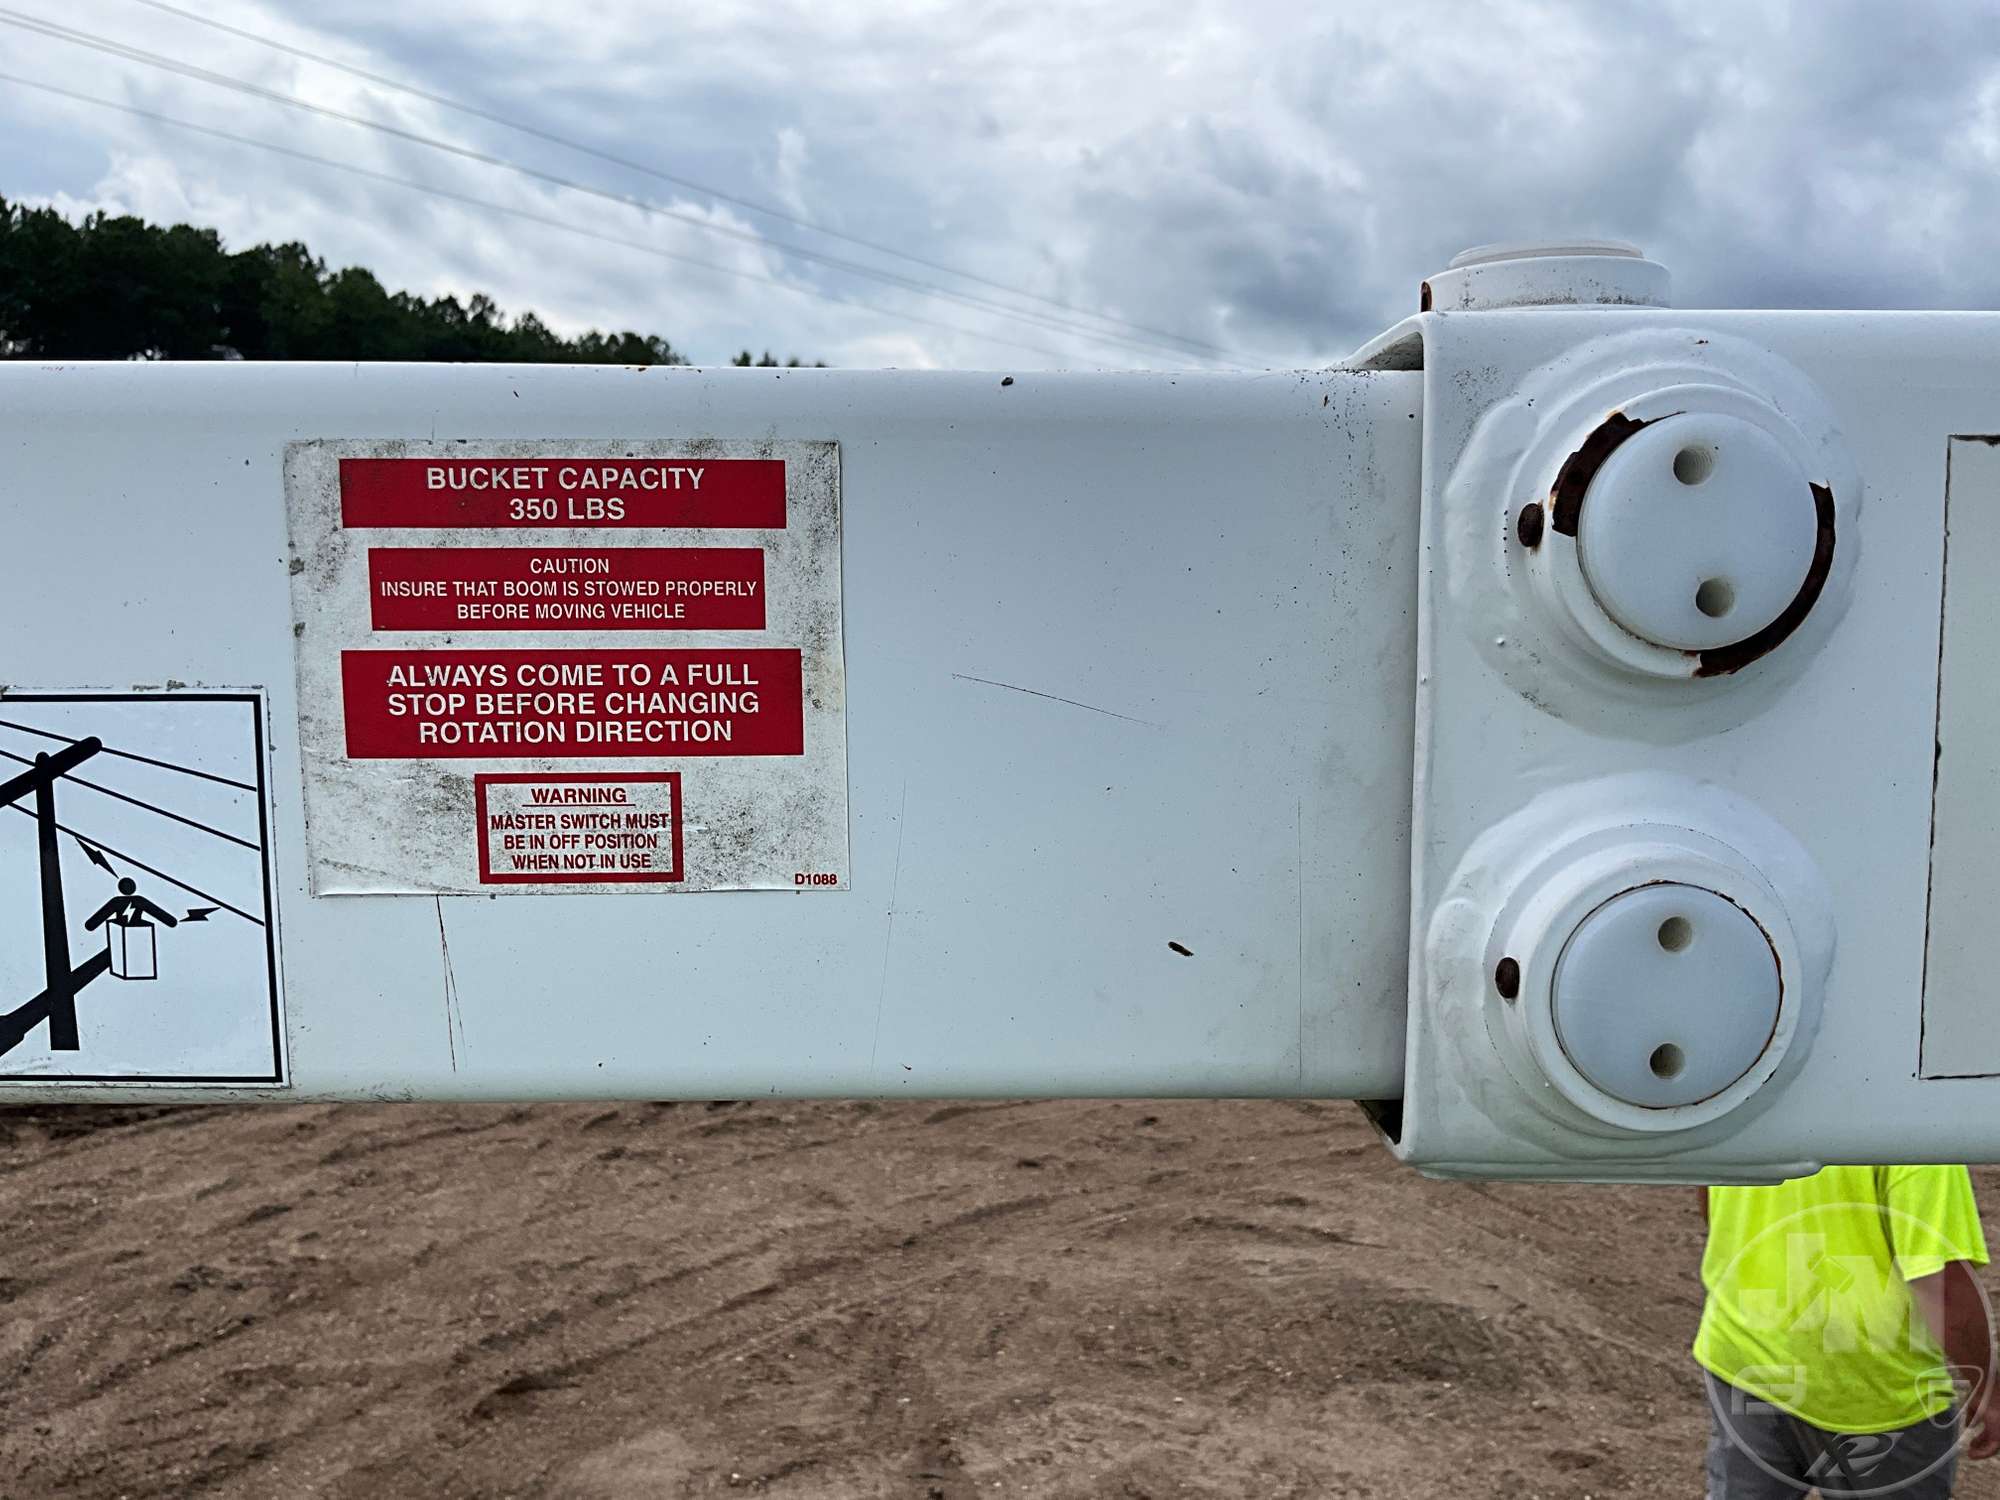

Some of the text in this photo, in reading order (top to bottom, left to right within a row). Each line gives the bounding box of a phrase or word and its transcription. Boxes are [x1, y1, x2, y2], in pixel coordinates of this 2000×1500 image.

[427, 468, 704, 490] BUCKET CAPACITY
[510, 498, 625, 520] 350 LBS
[530, 558, 609, 574] CAUTION
[381, 580, 757, 597] INSURE THAT BOOM IS STOWED PROPERLY
[457, 603, 685, 619] BEFORE MOVING VEHICLE
[387, 665, 759, 687] ALWAYS COME TO A FULL
[388, 693, 759, 716] STOP BEFORE CHANGING
[419, 721, 732, 744] ROTATION DIRECTION
[531, 788, 627, 804] WARNING
[491, 813, 669, 830] MASTER SWITCH MUST
[504, 834, 658, 850] BE IN OFF POSITION
[511, 854, 652, 869] WHEN NOT IN USE
[795, 873, 837, 885] D1088
